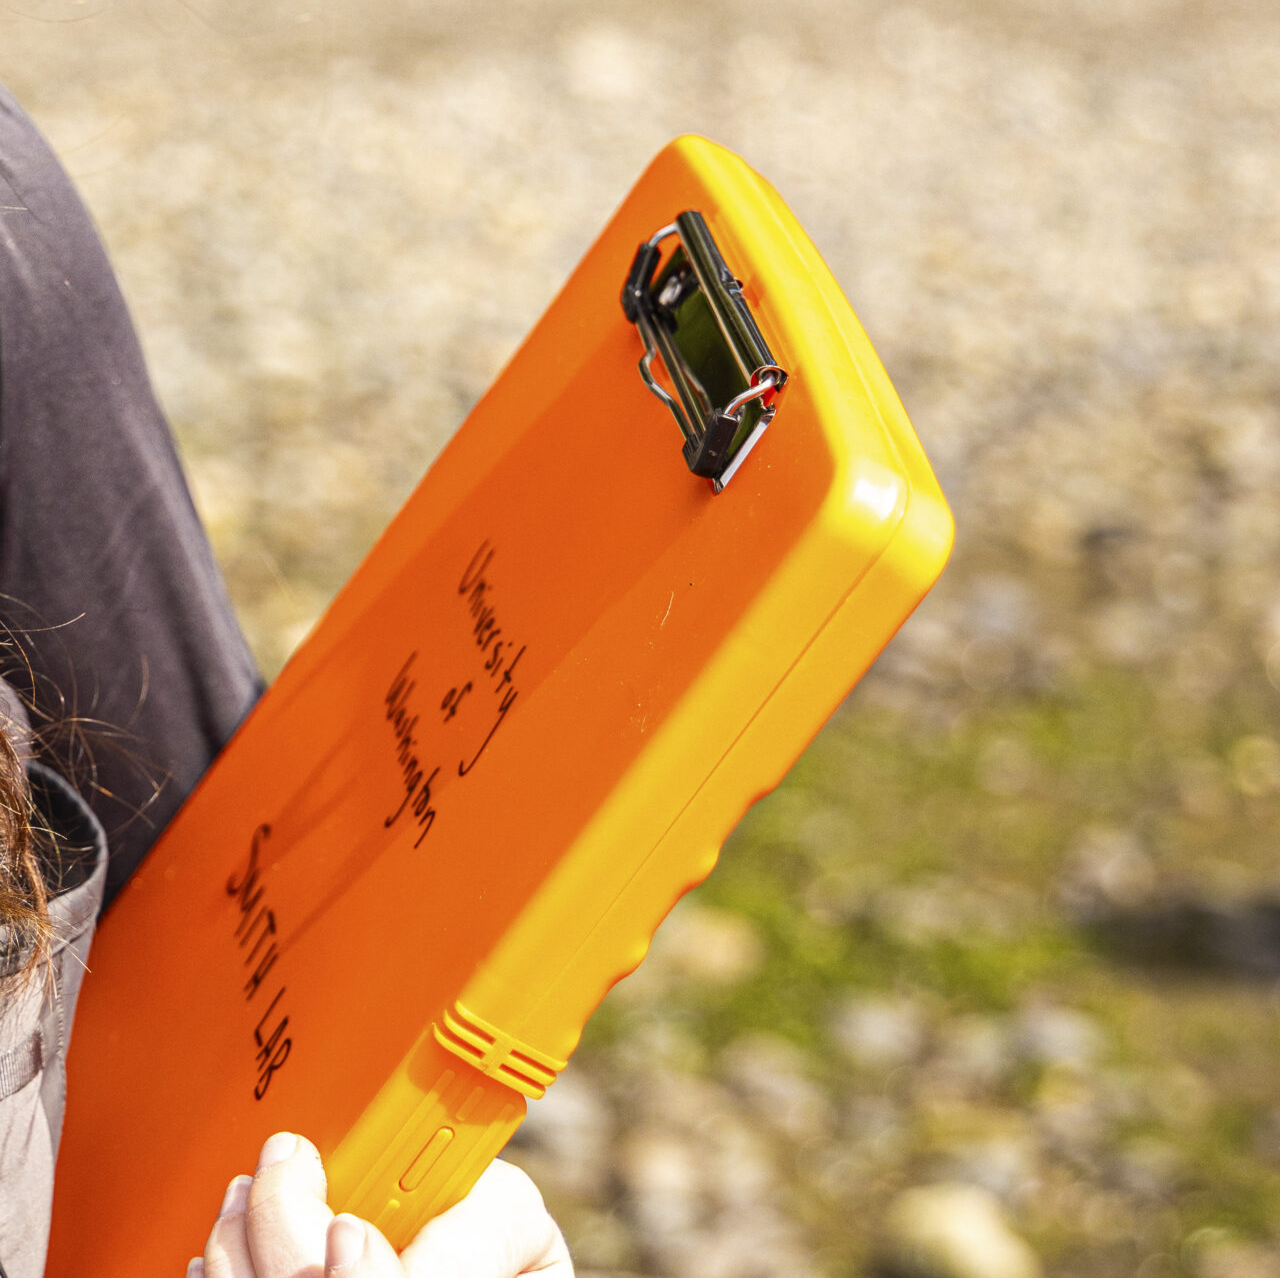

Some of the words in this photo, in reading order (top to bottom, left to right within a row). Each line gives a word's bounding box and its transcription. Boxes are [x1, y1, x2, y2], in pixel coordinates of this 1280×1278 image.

[384, 649, 440, 850] Washington
[440, 680, 473, 724] of
[459, 538, 527, 777] University
[225, 822, 278, 1001] SMITH
[253, 986, 293, 1101] LAB
